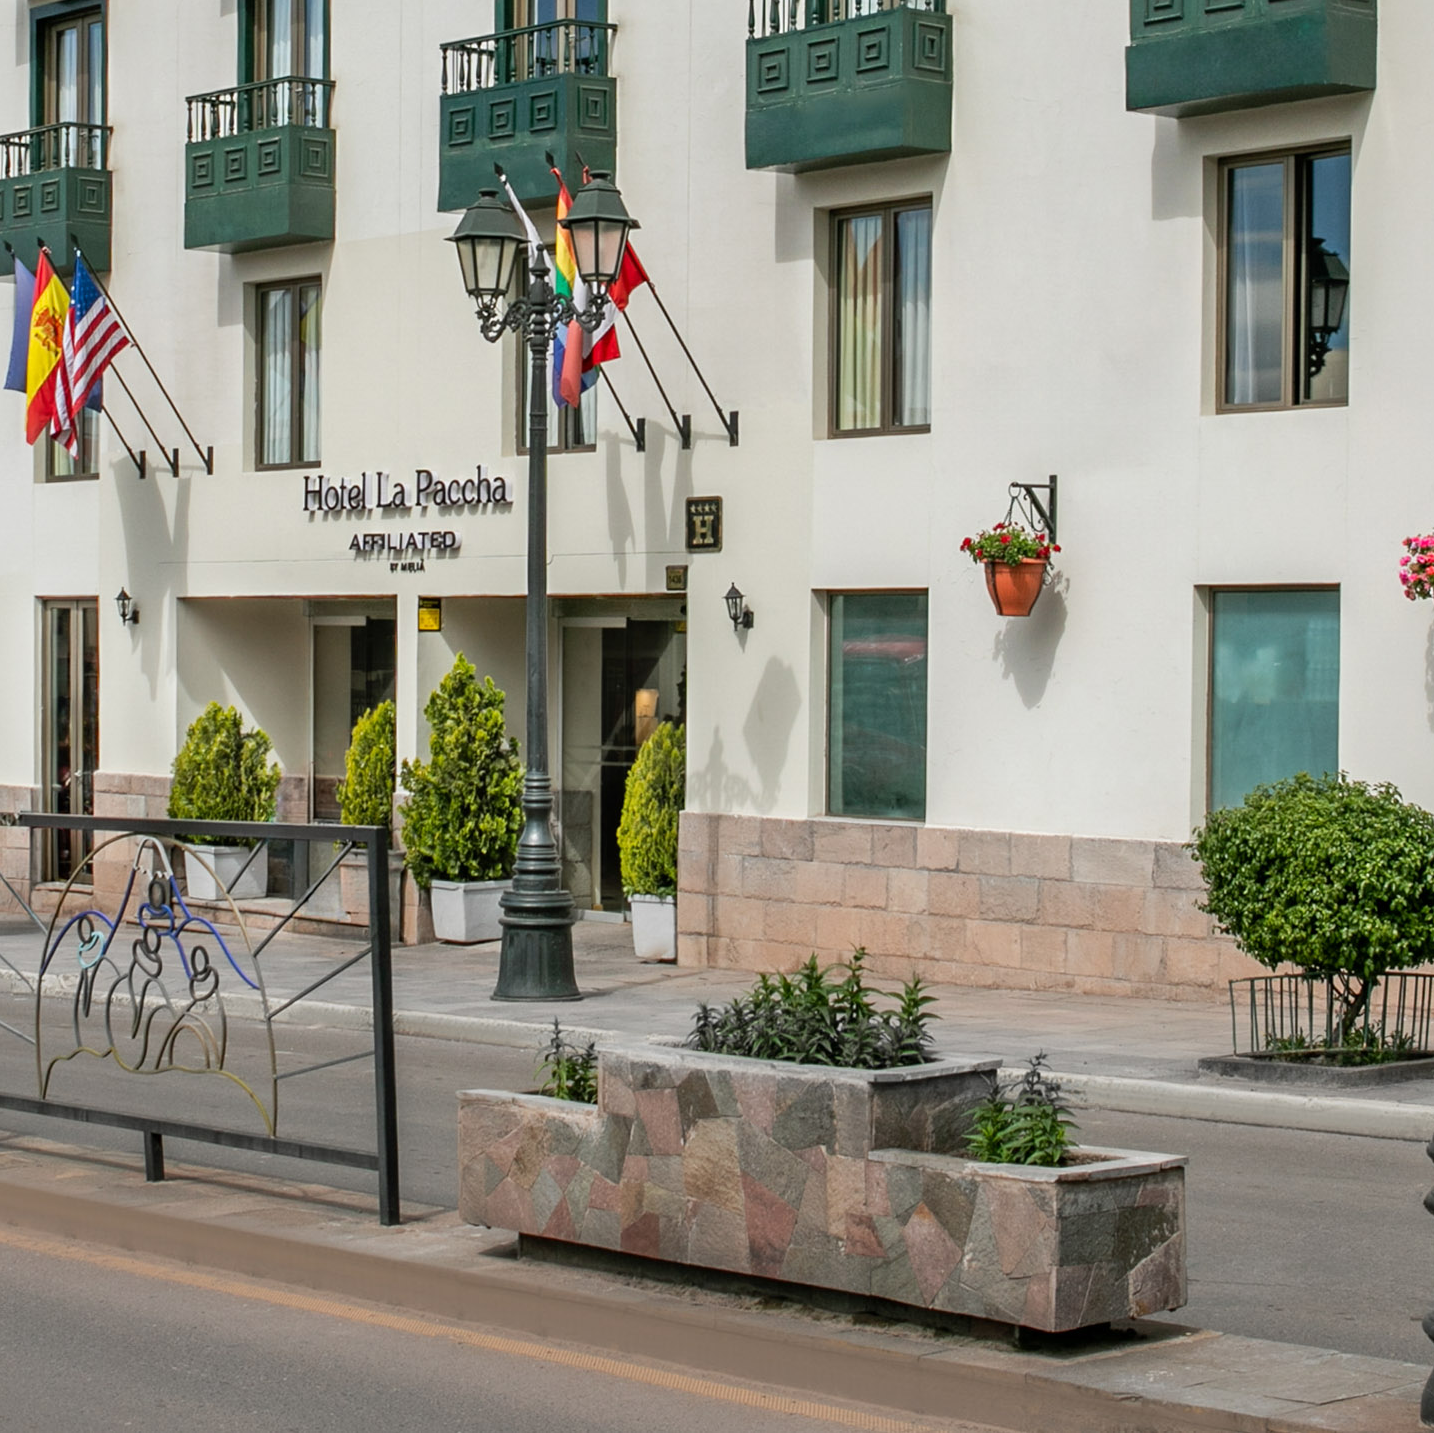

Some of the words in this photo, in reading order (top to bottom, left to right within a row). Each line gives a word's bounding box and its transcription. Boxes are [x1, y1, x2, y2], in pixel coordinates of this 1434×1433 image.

[303, 471, 367, 511] Hotel
[376, 471, 406, 508] La
[415, 464, 508, 507] Paccha
[349, 531, 457, 551] AFFILIATED
[692, 515, 714, 545] H
